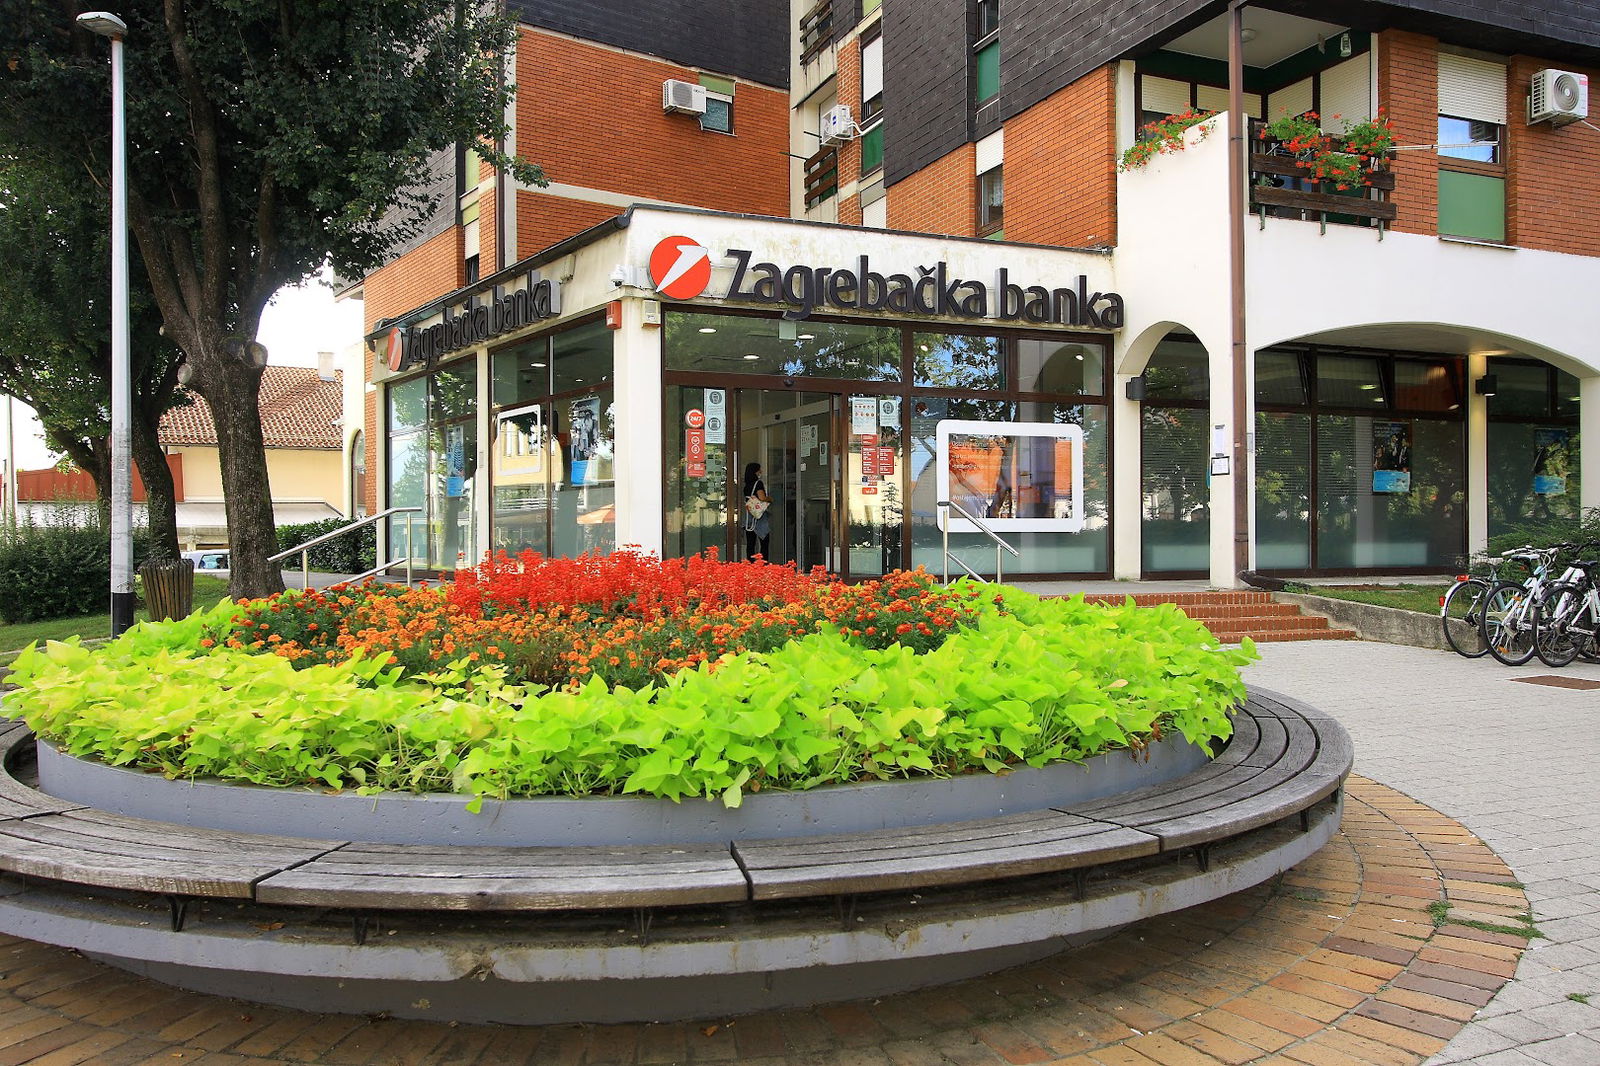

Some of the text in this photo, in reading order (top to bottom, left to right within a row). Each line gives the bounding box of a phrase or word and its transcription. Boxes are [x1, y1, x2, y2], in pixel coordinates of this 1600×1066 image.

[403, 271, 561, 370] Zagrebačka banka
[725, 249, 1125, 329] Zagrebačka banka
